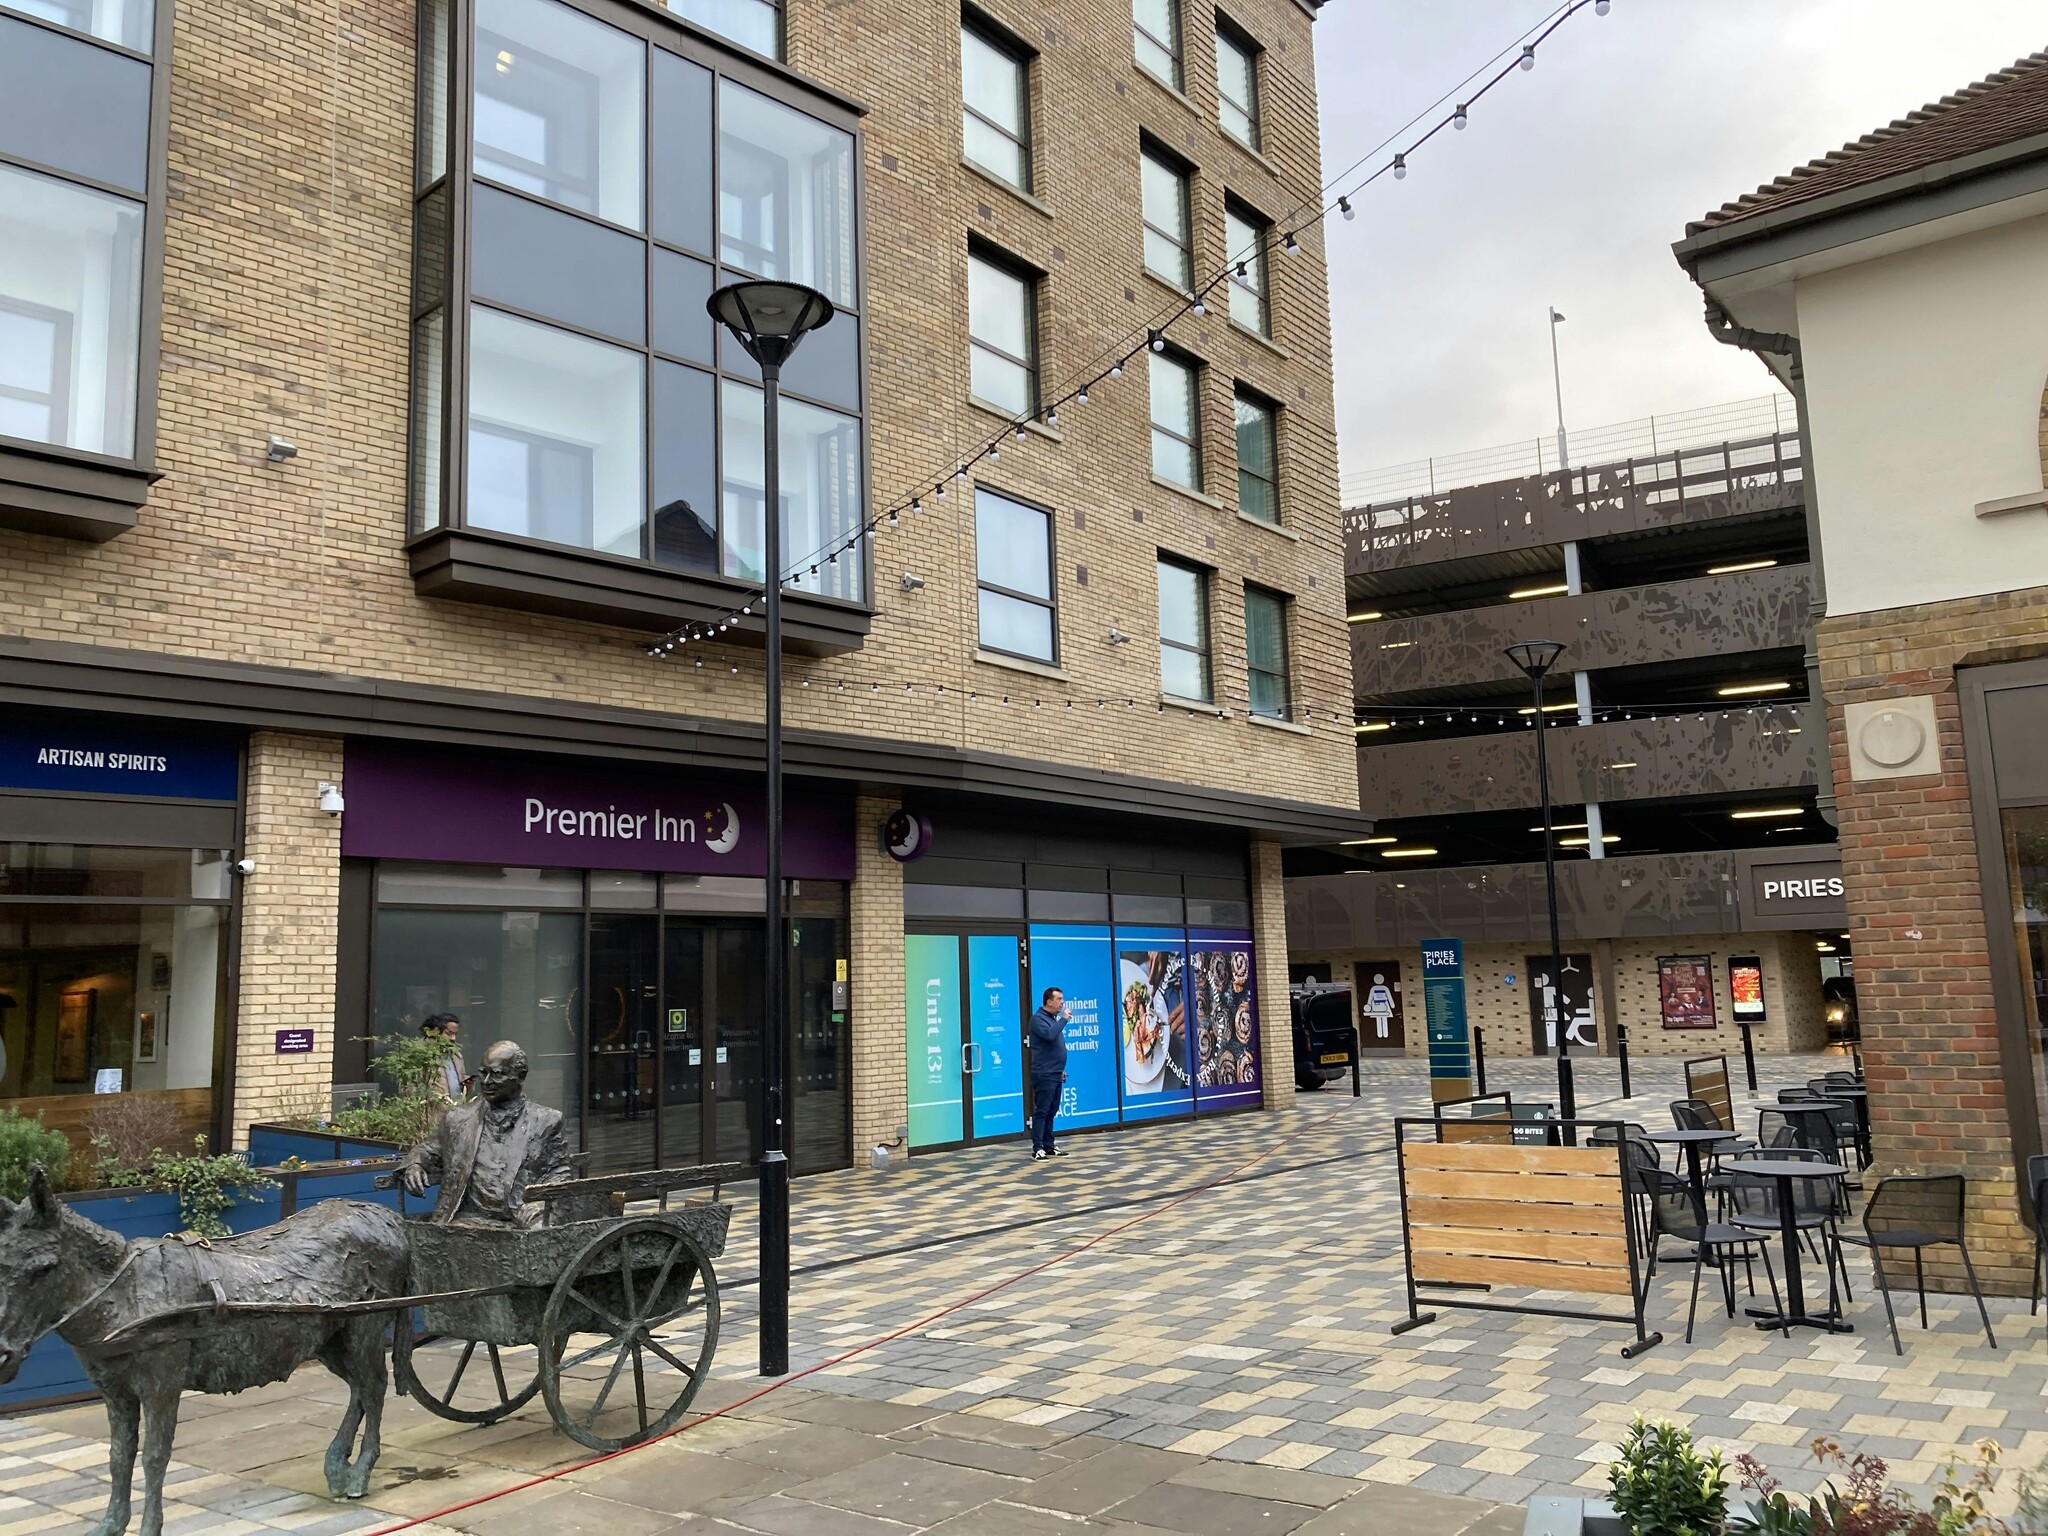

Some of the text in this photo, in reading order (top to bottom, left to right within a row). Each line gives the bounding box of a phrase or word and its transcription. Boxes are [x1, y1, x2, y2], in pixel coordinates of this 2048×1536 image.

[37, 747, 168, 772] ARTISAN SPIRITS
[525, 798, 696, 843] Premier Inn
[1763, 877, 1845, 900] PIRIES
[1423, 950, 1455, 959] PIRIES
[1426, 957, 1458, 969] PLACE
[926, 977, 942, 1038] Unit
[1068, 1025, 1082, 1037] and
[1084, 1025, 1099, 1037] F&B
[927, 1045, 943, 1072] 13
[1054, 1102, 1078, 1118] ACE
[1513, 1127, 1544, 1135] GG BITES
